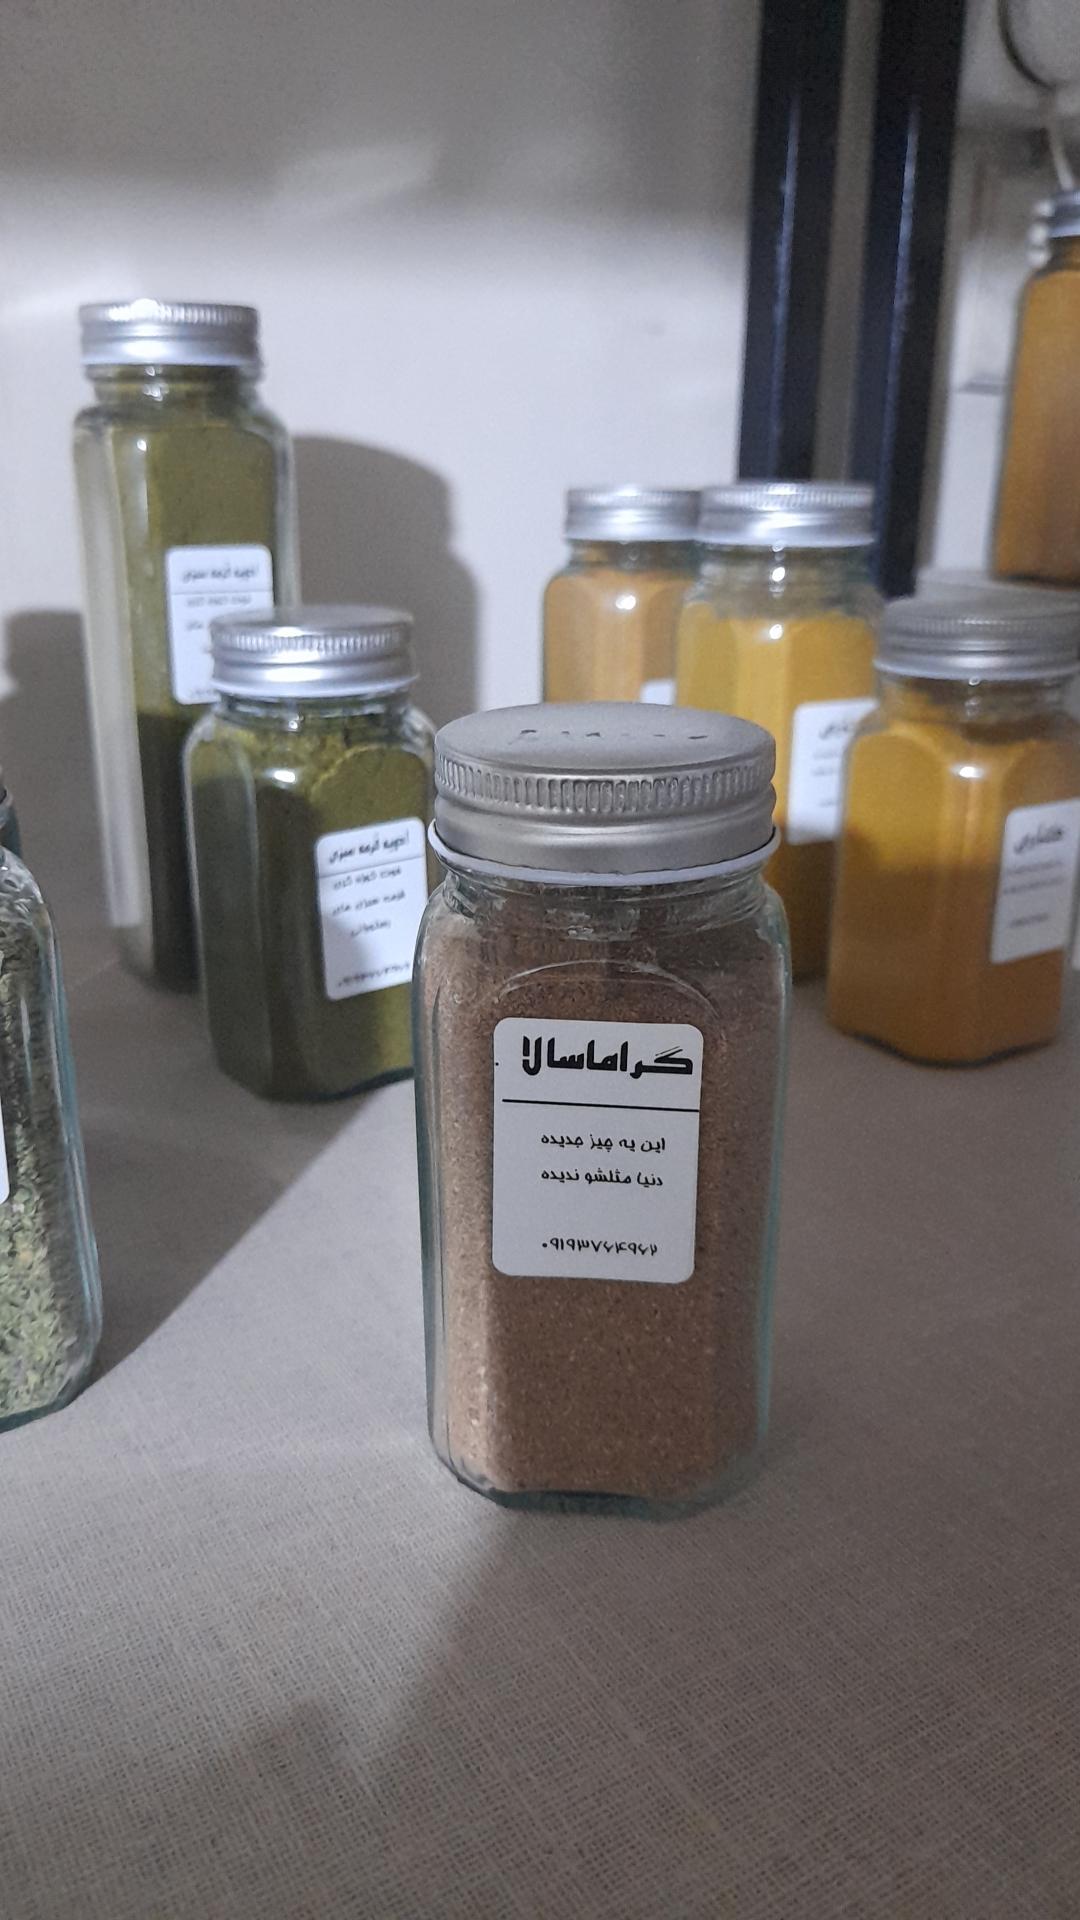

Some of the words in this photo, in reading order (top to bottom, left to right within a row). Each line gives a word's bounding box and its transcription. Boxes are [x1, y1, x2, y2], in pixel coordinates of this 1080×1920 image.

[541, 1134, 584, 1148] جدیده
[590, 1134, 613, 1152] چیز
[619, 1138, 636, 1152] یه
[640, 1138, 666, 1153] این
[541, 1168, 580, 1183] ندیده
[584, 1167, 632, 1185] مثلشو
[636, 1171, 664, 1187] دنیا
